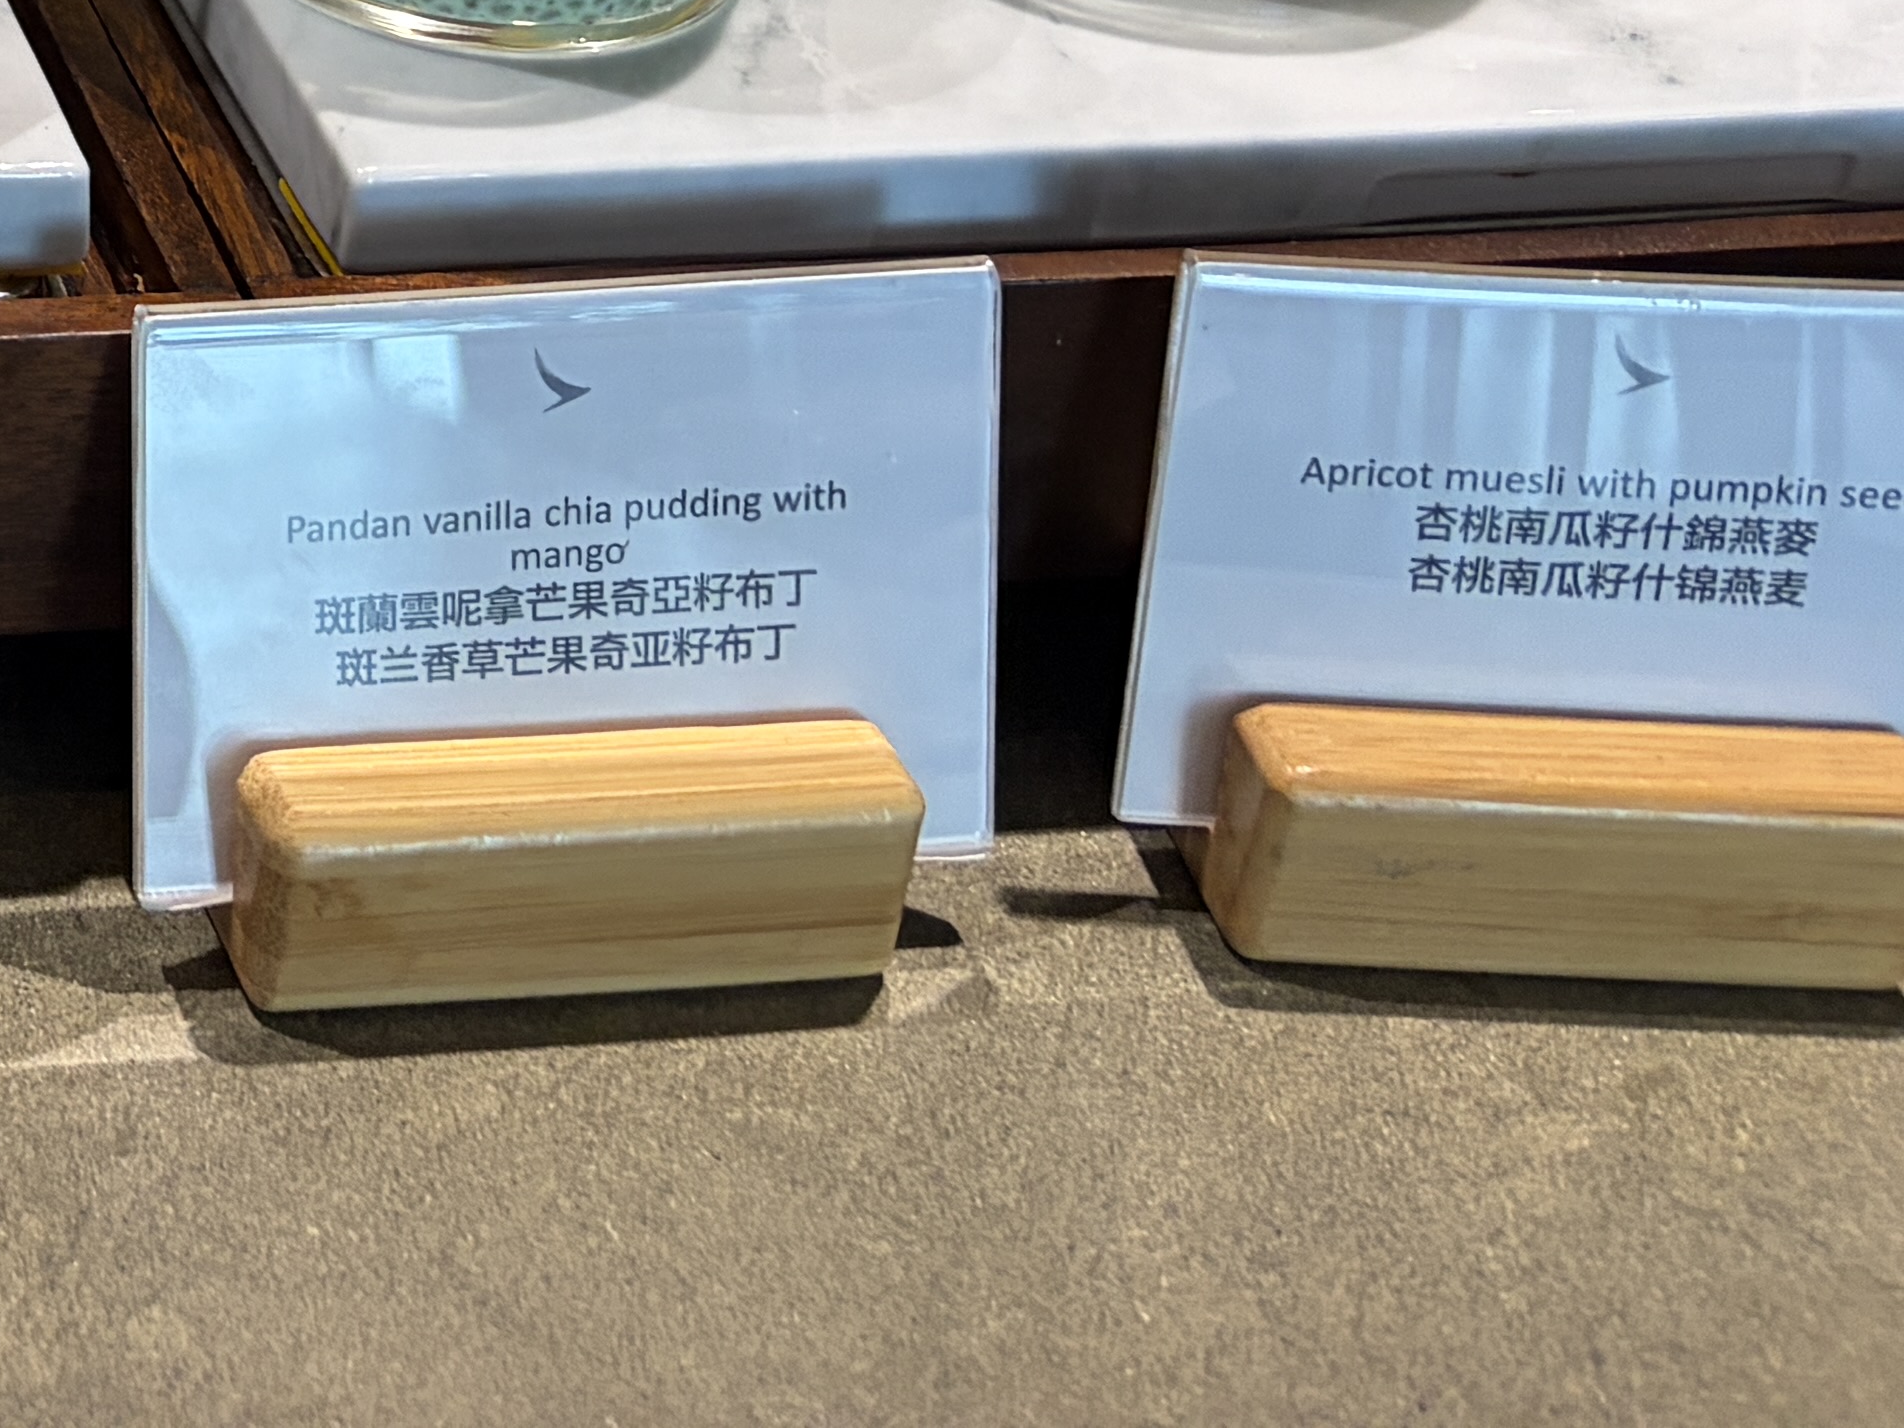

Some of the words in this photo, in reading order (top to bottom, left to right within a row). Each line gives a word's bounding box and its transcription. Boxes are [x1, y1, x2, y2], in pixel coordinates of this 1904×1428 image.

[287, 509, 411, 544] Pandan
[423, 499, 532, 535] vanilla
[544, 495, 612, 527] chia
[624, 487, 762, 531] pudding
[772, 479, 847, 513] with
[1299, 456, 1434, 493] Apricot
[1444, 464, 1567, 495] muesli
[1577, 468, 1656, 500] with
[1668, 474, 1828, 511] pumpkin
[510, 541, 626, 573] mango
[1414, 501, 1819, 557] 杏桃南瓜籽什錦燕麥
[313, 568, 818, 636] 斑蘭雲呢拿芒果奇亞籽布丁
[1408, 553, 1809, 608] 杏桃南瓜籽什锦燕麦
[335, 623, 797, 687] 斑兰香草芒果奇亚籽布丁
